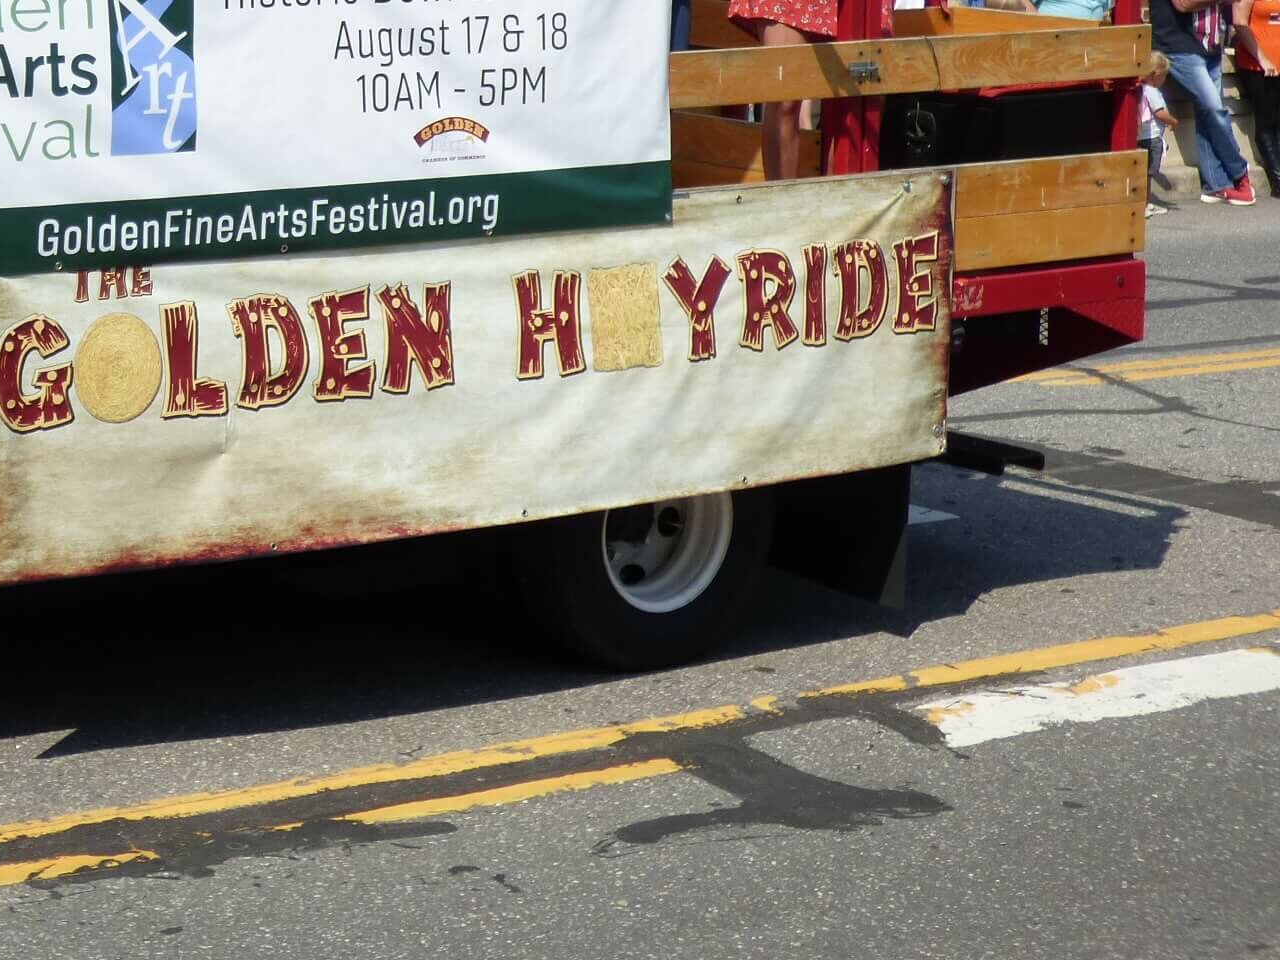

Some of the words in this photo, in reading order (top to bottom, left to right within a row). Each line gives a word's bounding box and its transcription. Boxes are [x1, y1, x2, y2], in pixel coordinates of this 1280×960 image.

[333, 19, 451, 67] August
[461, 15, 490, 55] 17
[502, 13, 525, 53] &
[536, 11, 569, 51] 18
[356, 70, 442, 113] 10AM
[478, 66, 548, 107] 5PM
[420, 118, 486, 141] GOLDEN
[36, 192, 500, 257] GoldenFineArtsFestival.org
